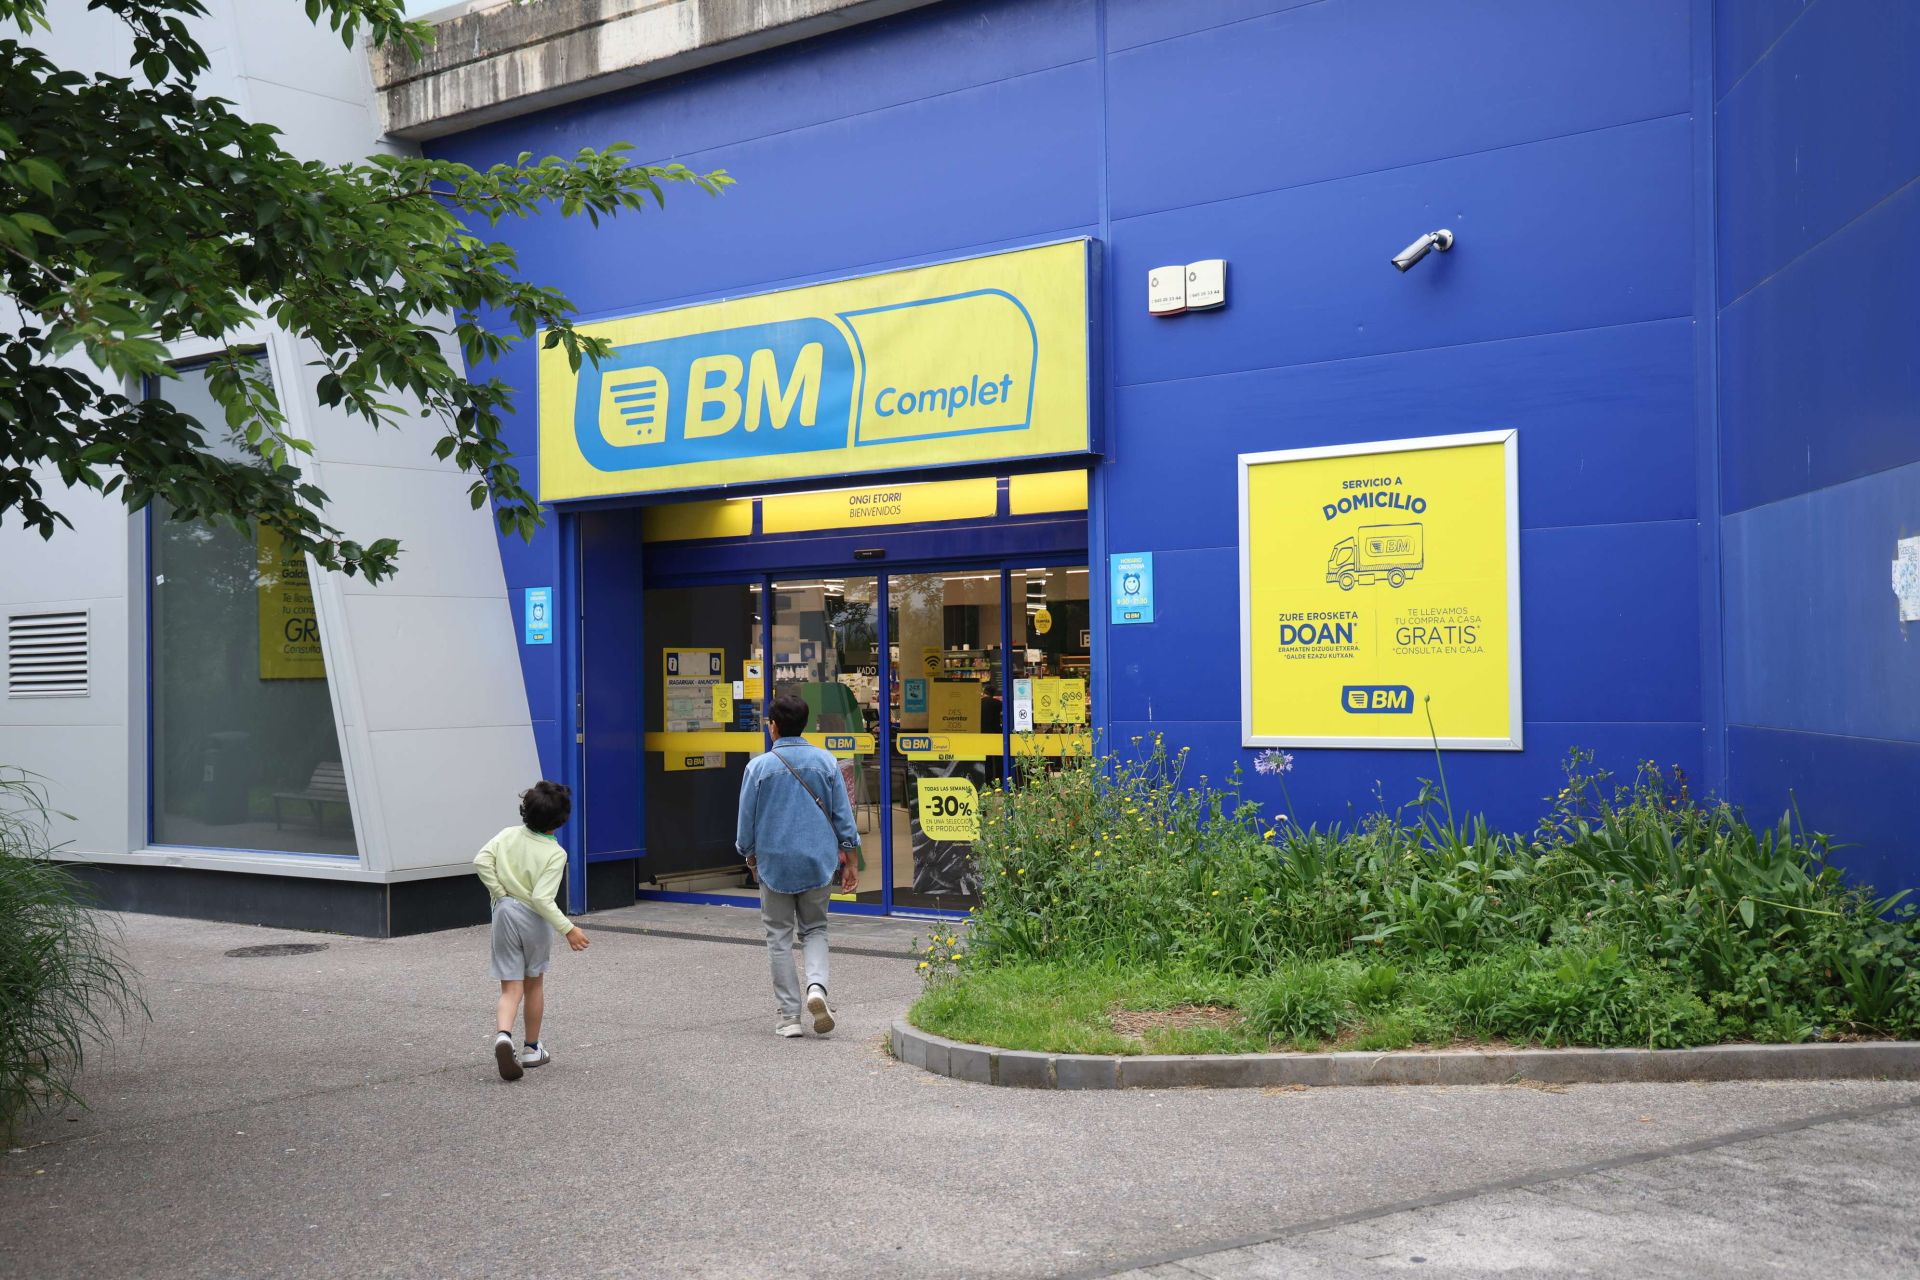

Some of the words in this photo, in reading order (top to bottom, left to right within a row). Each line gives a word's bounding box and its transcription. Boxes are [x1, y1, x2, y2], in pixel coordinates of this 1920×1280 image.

[683, 341, 824, 440] BM
[875, 373, 1013, 418] Complet
[1342, 478, 1392, 489] SERVICIO
[1395, 476, 1402, 485] A
[849, 494, 871, 505] ONGI
[873, 492, 902, 504] ETORRI
[850, 504, 901, 518] BIENVENIDOS
[1322, 491, 1427, 521] DOMICILIO
[1386, 539, 1411, 553] BM
[1279, 613, 1304, 622] ZURE
[1306, 612, 1358, 620] EROSKETA
[1408, 608, 1418, 616] TE
[1420, 607, 1468, 616] LLEVAMOS
[1395, 617, 1406, 625] TU
[1408, 616, 1446, 625] COMPRA
[1448, 616, 1456, 624] A
[1457, 616, 1482, 624] CASA
[1445, 646, 1456, 654] EN
[1372, 690, 1406, 709] BM
[838, 737, 853, 748] BM
[912, 739, 928, 749] BM
[926, 795, 972, 817] -30%
